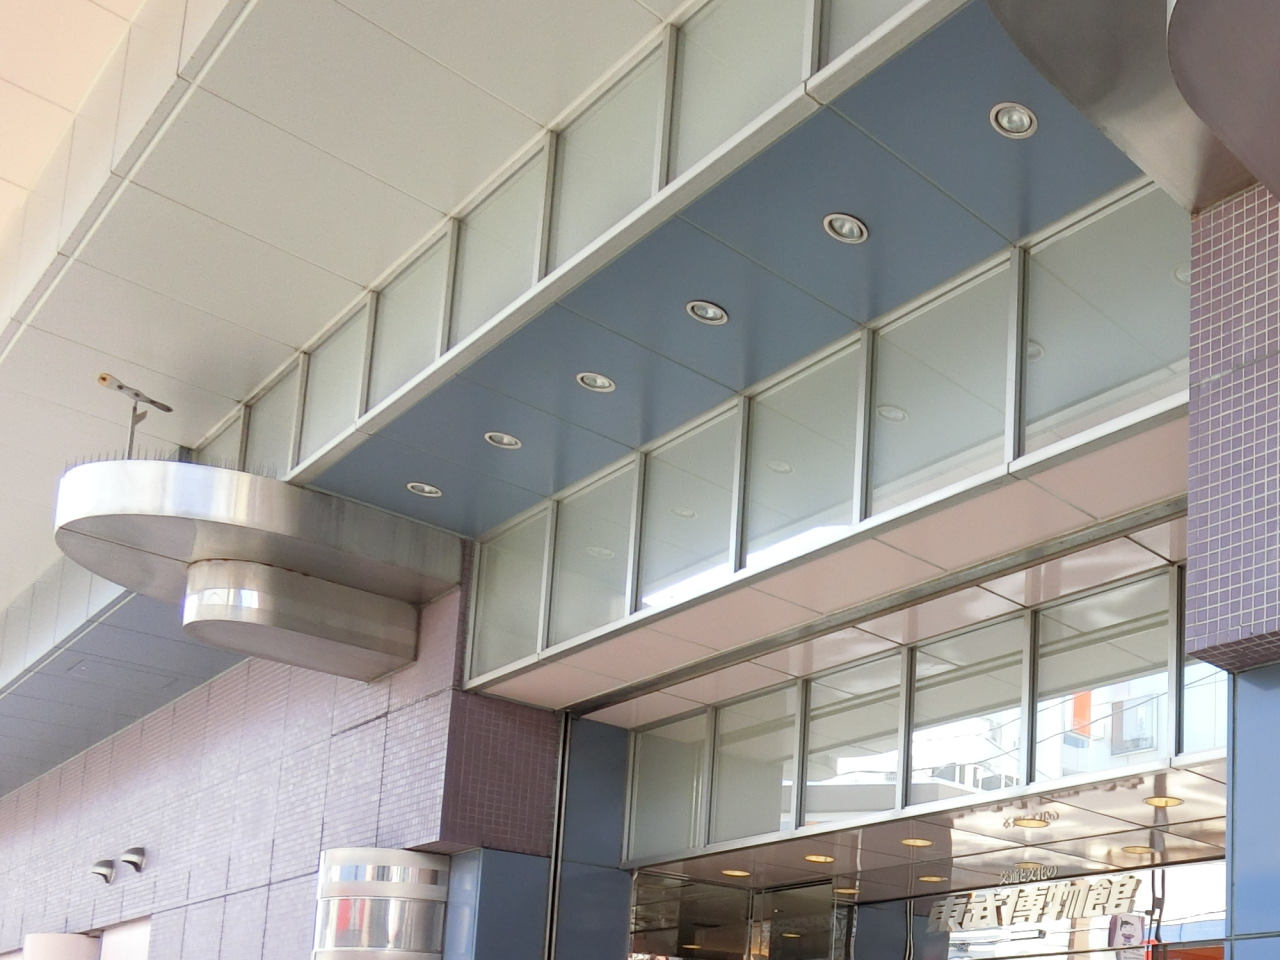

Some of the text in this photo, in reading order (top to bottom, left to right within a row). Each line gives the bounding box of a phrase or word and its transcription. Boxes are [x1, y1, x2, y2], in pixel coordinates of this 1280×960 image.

[926, 876, 1142, 933] 東武博物館
